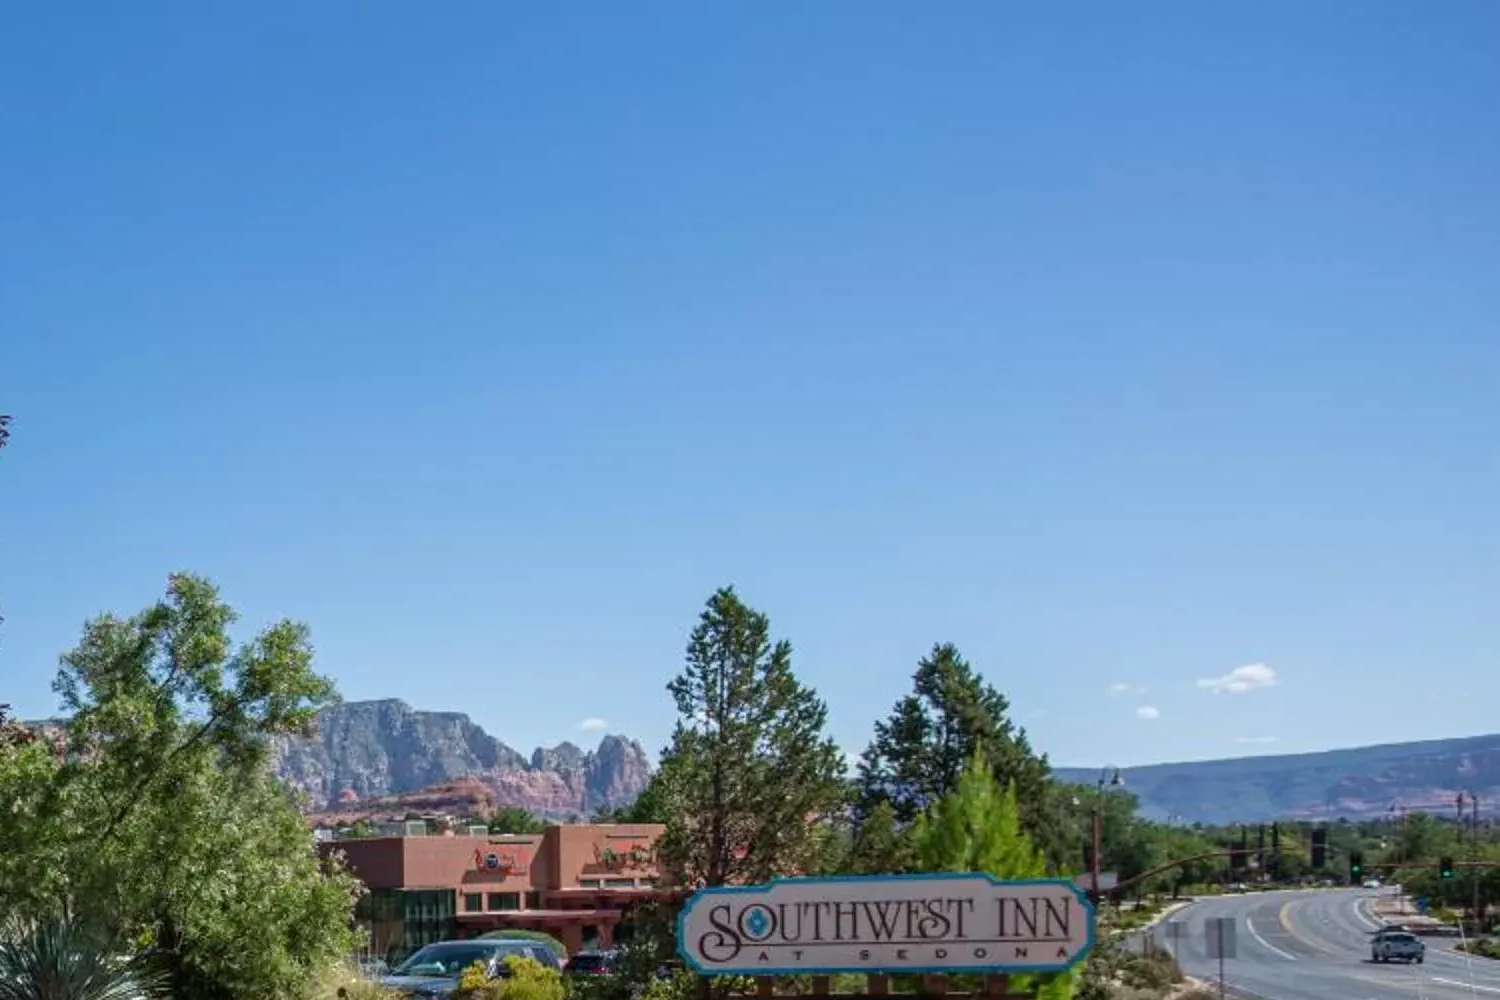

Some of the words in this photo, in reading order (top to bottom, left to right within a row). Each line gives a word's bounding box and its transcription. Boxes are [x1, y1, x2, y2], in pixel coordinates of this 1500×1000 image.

[699, 898, 974, 962] SOUTHWEST
[996, 896, 1073, 938] INN
[758, 951, 804, 961] AT
[859, 947, 1068, 960] SEDONA
